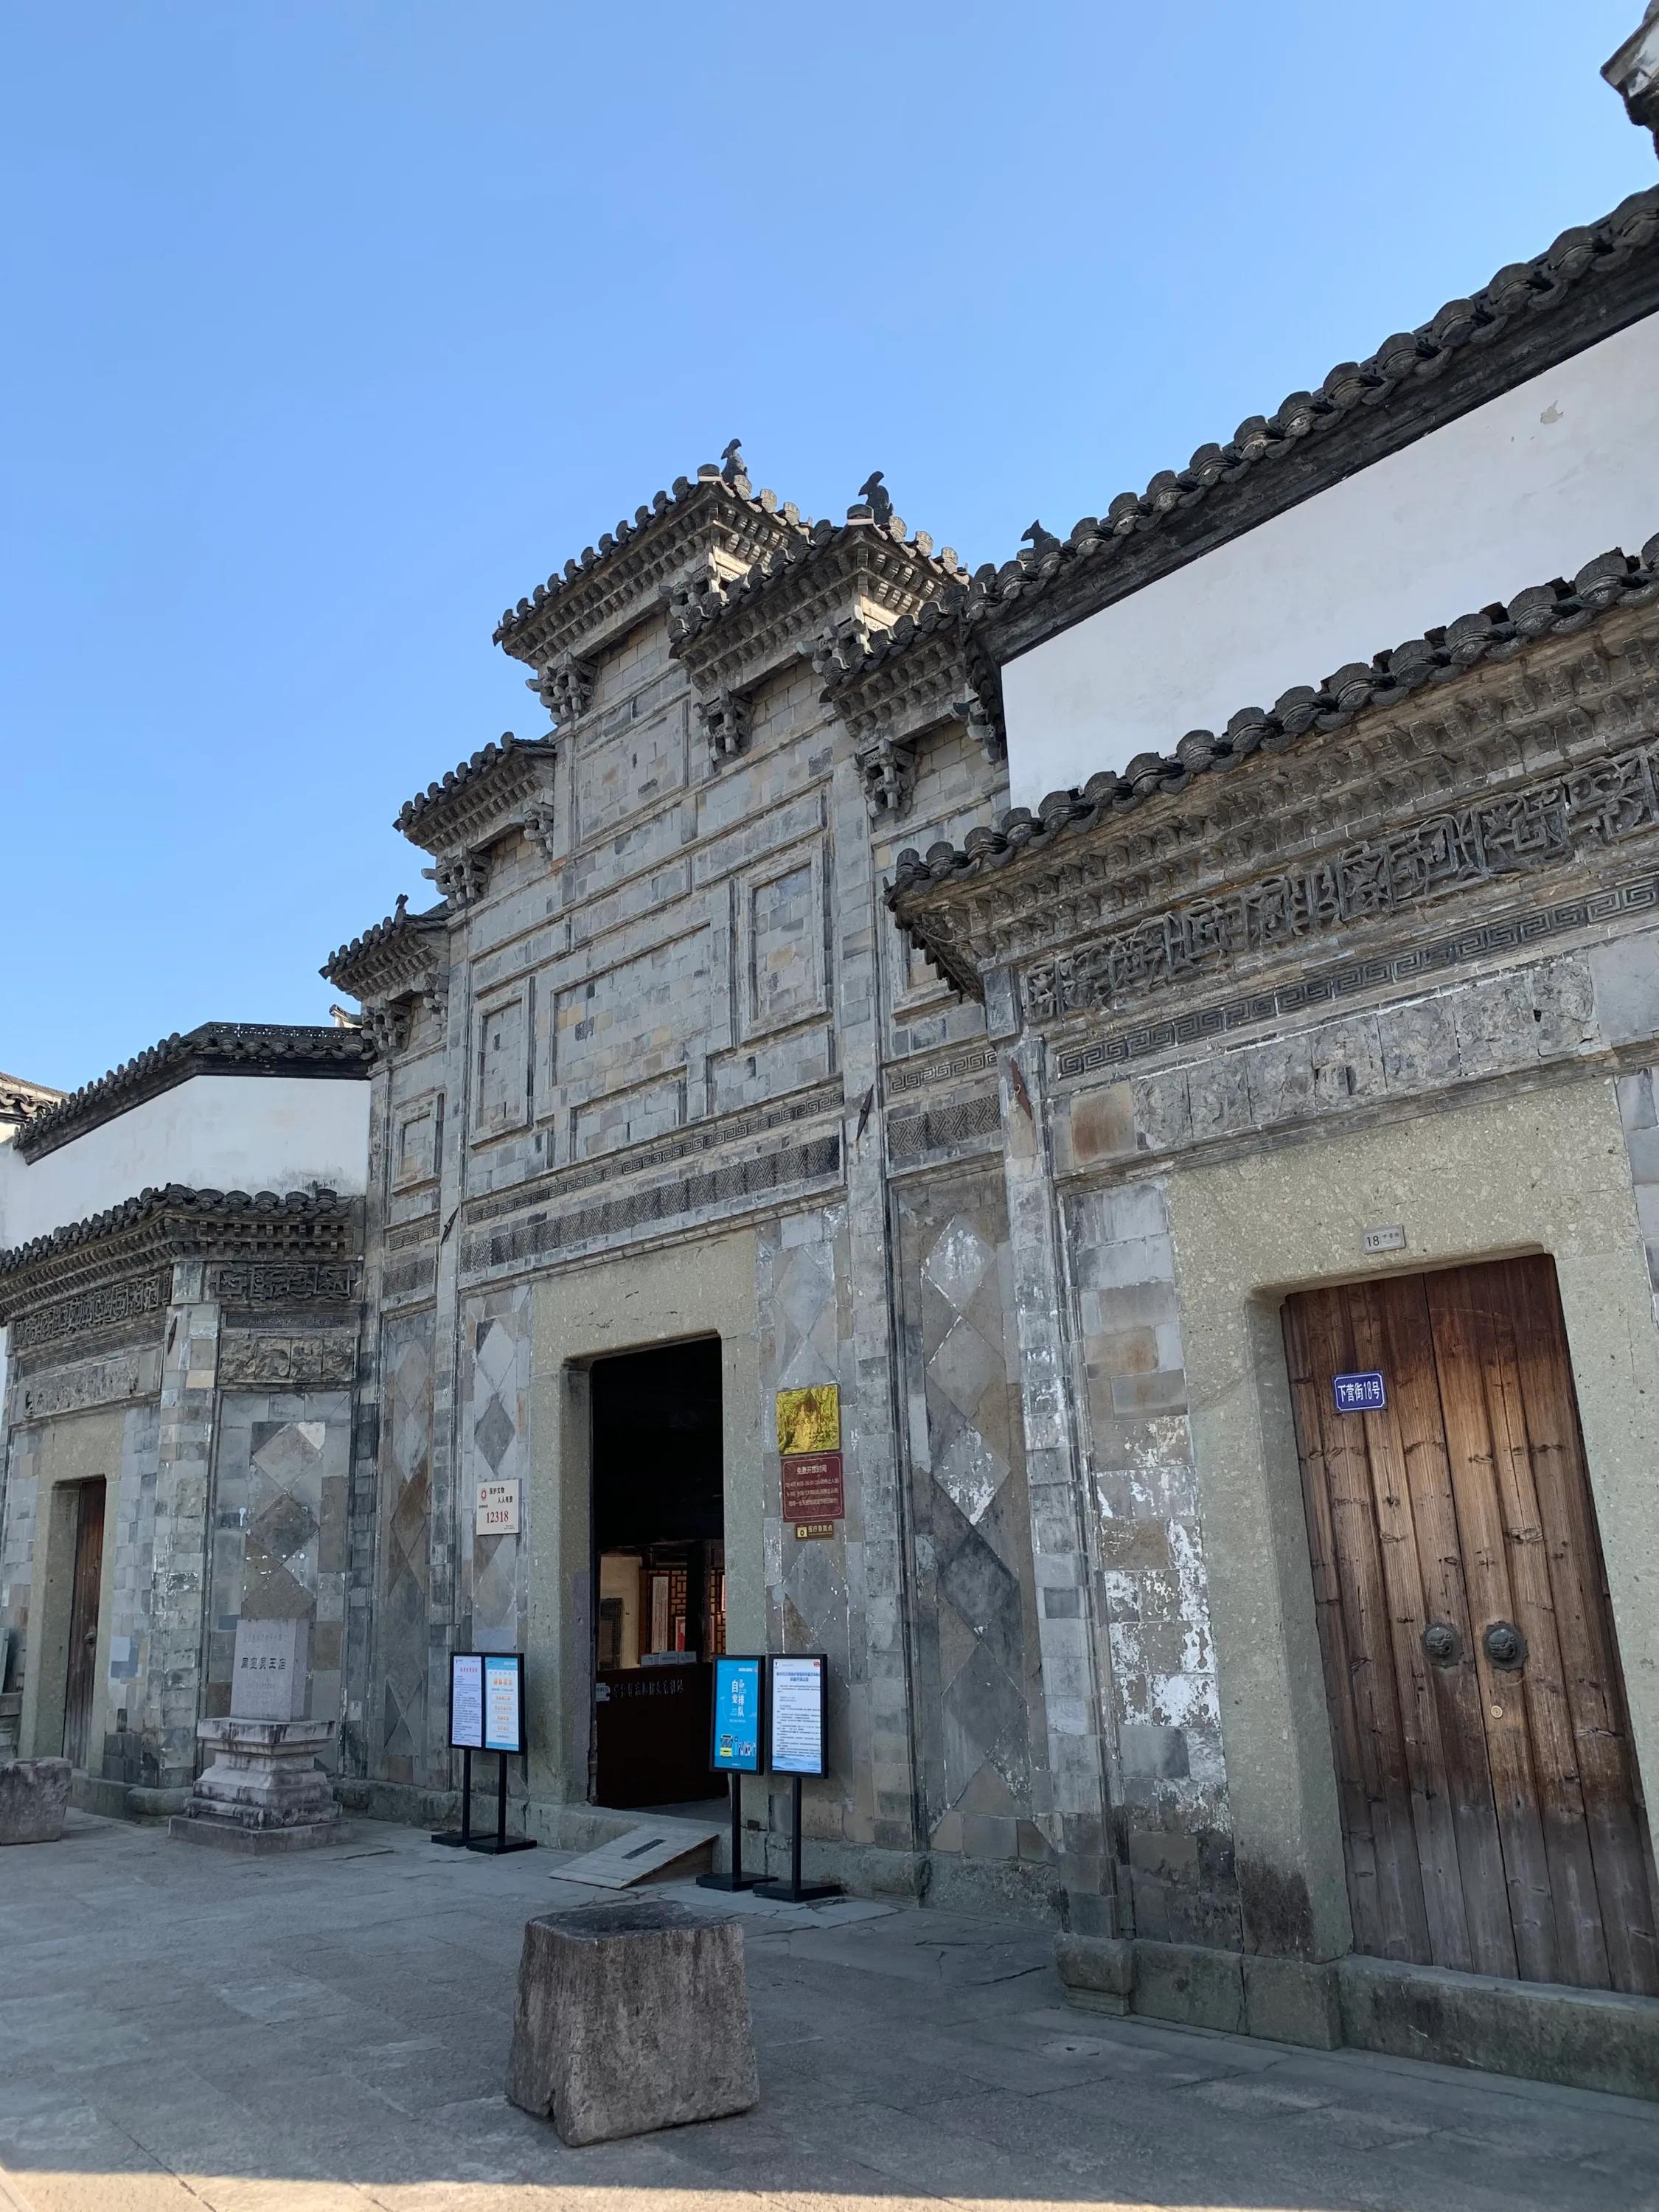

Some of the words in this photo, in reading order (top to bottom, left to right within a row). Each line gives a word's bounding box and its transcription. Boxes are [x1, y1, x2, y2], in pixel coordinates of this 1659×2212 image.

[1366, 1235, 1380, 1247] 18
[1337, 1380, 1380, 1402] 下营街18号
[487, 1510, 509, 1523] 12318
